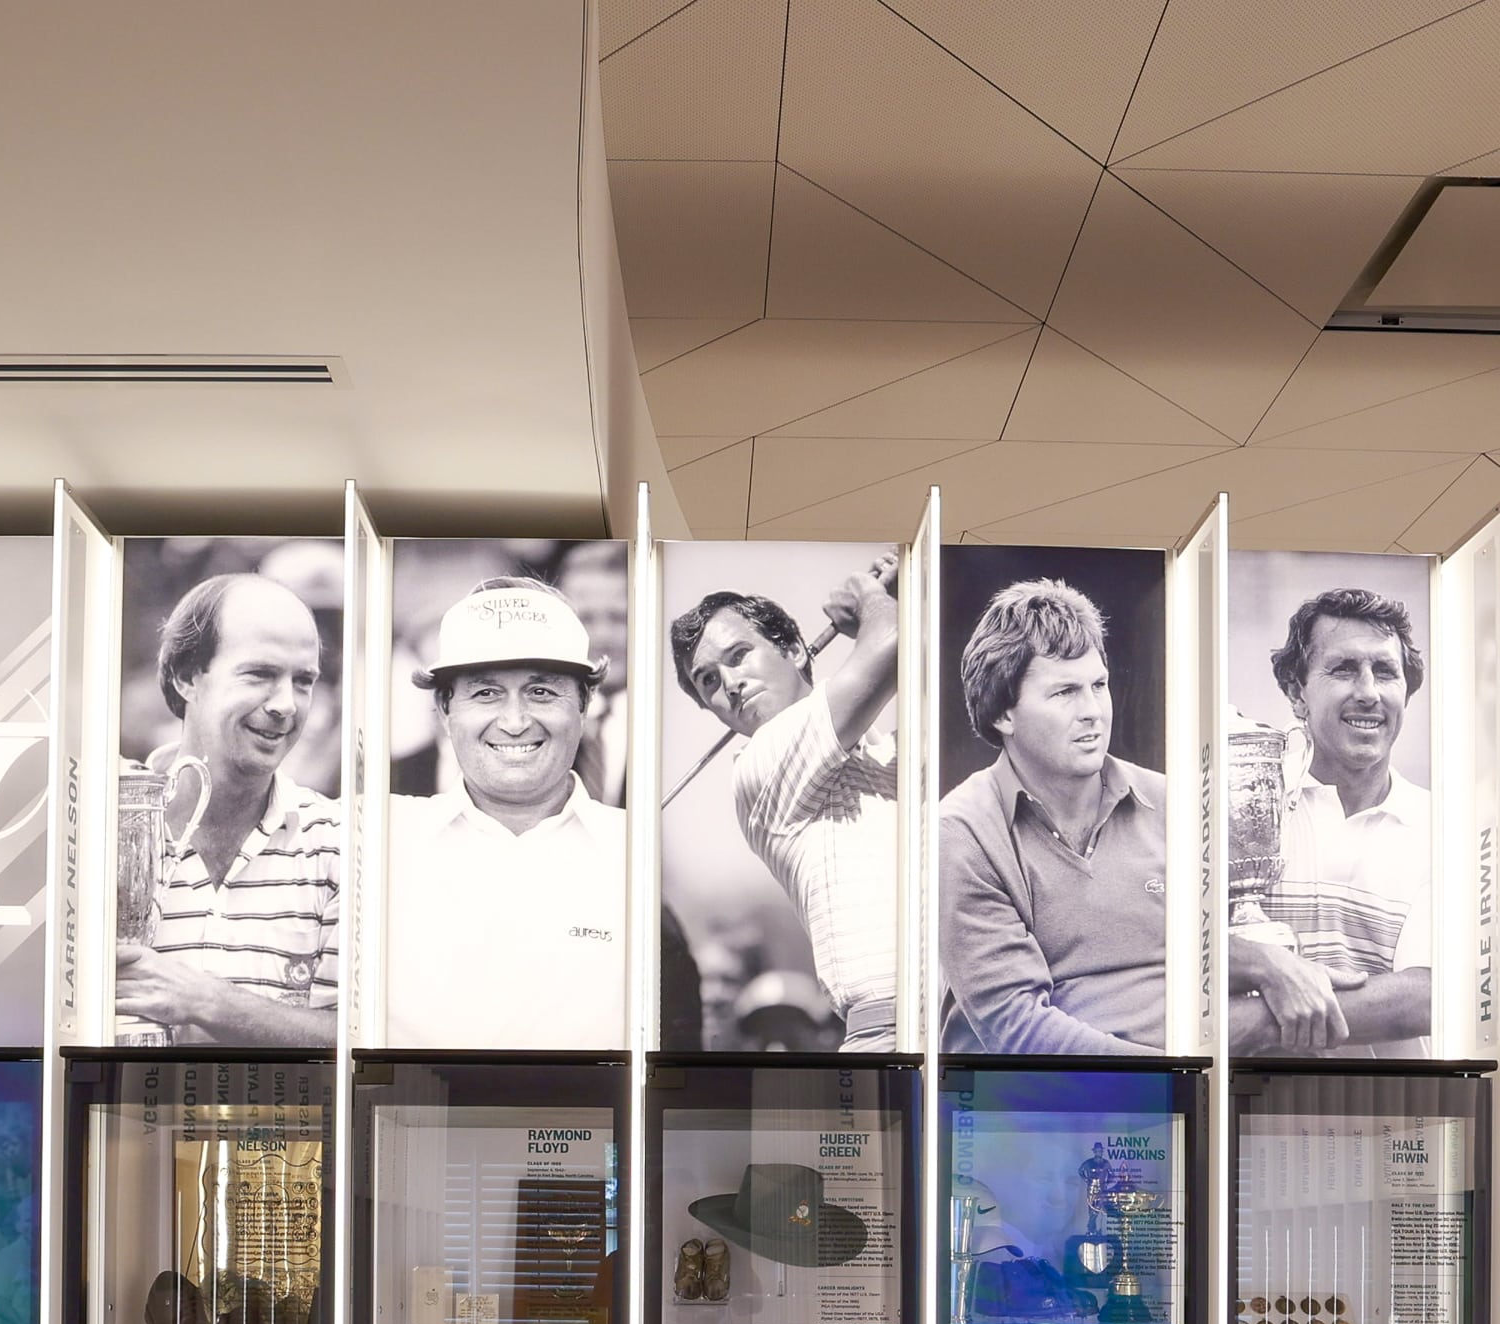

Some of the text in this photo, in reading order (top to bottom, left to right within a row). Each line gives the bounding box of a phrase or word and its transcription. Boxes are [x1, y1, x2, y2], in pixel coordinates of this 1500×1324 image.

[65, 757, 78, 1009] LARRY NELSON
[1201, 742, 1211, 1019] LANNY WADKINS
[1480, 827, 1492, 1022] HALE IRWIN
[569, 926, 612, 942] aureus
[528, 1129, 592, 1141] RAYMOND
[819, 1133, 870, 1145] HUBERT
[237, 1141, 287, 1151] NELSON
[1107, 1136, 1150, 1147] LANNY
[1392, 1140, 1424, 1151] HALE
[528, 1142, 569, 1153] FLOYD
[819, 1146, 861, 1157] GREEN
[1107, 1149, 1165, 1160] WADKINS
[1392, 1152, 1429, 1163] IRWIN
